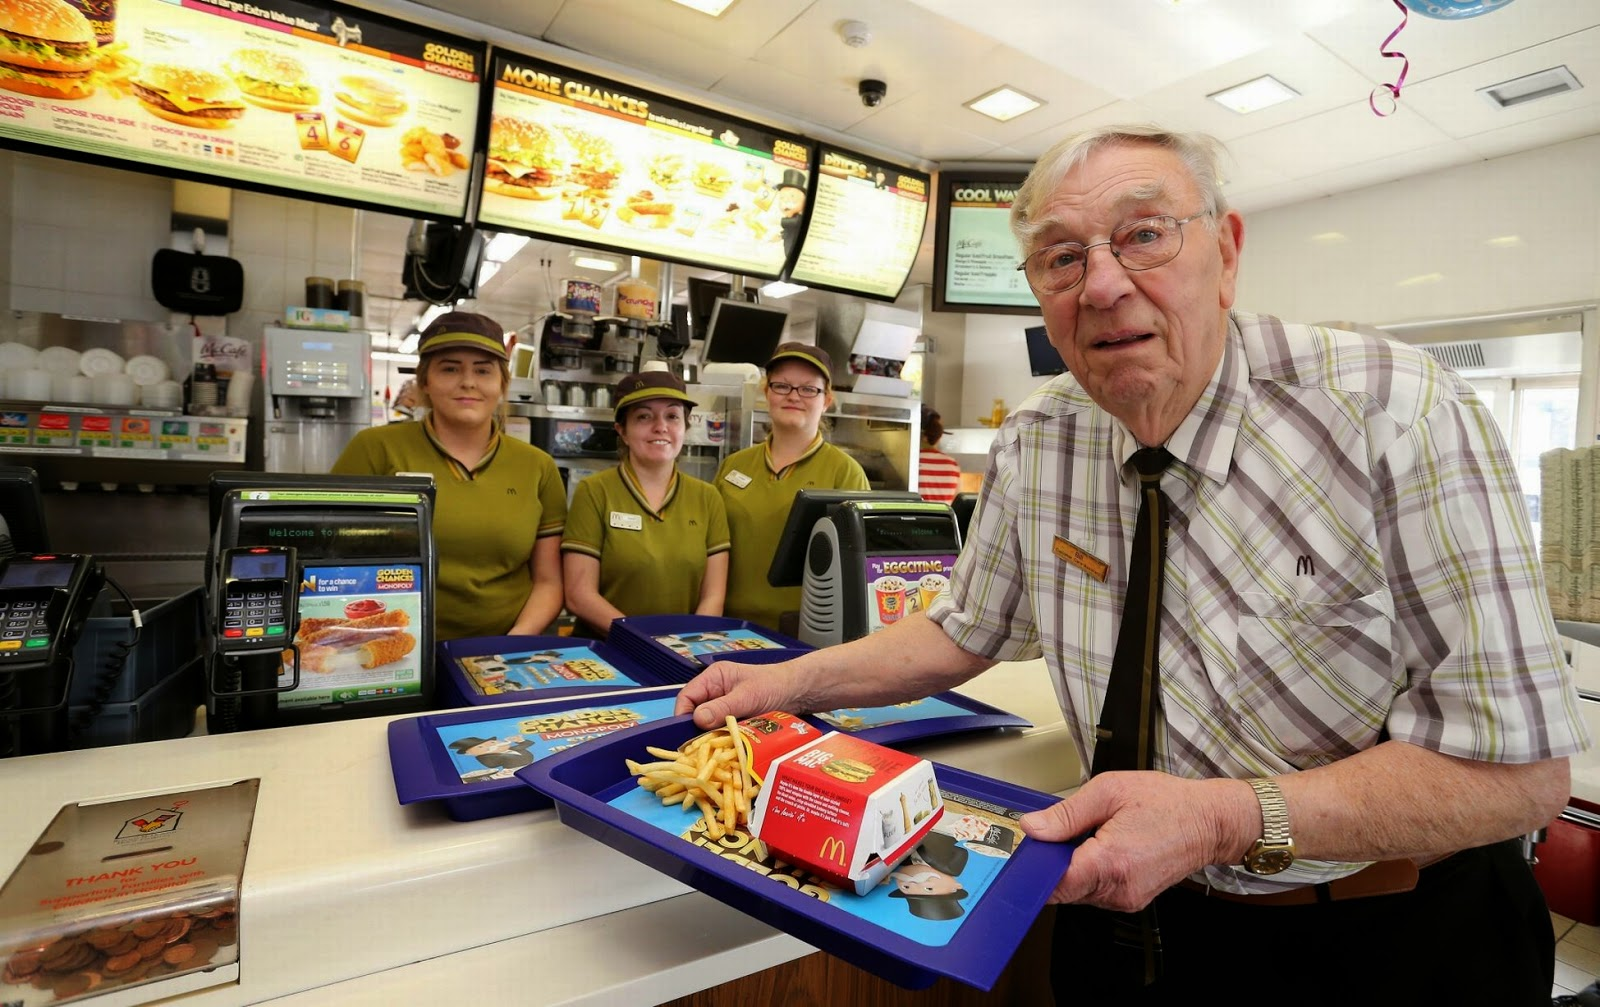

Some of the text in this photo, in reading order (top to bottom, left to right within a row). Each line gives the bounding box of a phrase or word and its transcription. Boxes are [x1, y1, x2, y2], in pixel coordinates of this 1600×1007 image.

[244, 4, 270, 18] Extra
[270, 11, 295, 26] Value
[424, 42, 474, 64] GOLDEN
[423, 51, 475, 72] CHANCES
[425, 63, 473, 81] MONOPOLY
[502, 64, 561, 95] MORE
[563, 81, 649, 119] CHANCES
[51, 105, 89, 118] CHOOSE
[307, 126, 318, 141] 4
[339, 137, 350, 150] 6
[955, 189, 992, 201] COOL
[269, 528, 333, 537] Welcome to
[377, 568, 413, 577] GOLDEN
[883, 560, 942, 574] EGGCITING
[376, 574, 414, 583] CHANCES
[378, 582, 413, 590] MONOPOLY
[910, 597, 918, 610] 2
[519, 708, 636, 728] GOLDEN
[520, 713, 644, 734] CHANCES
[546, 721, 636, 740] MONOPOLY
[793, 757, 820, 768] MAC
[804, 749, 835, 763] BIG
[65, 857, 197, 889] THANK YOU
[39, 887, 117, 906] Supporting
[120, 876, 175, 890] Families
